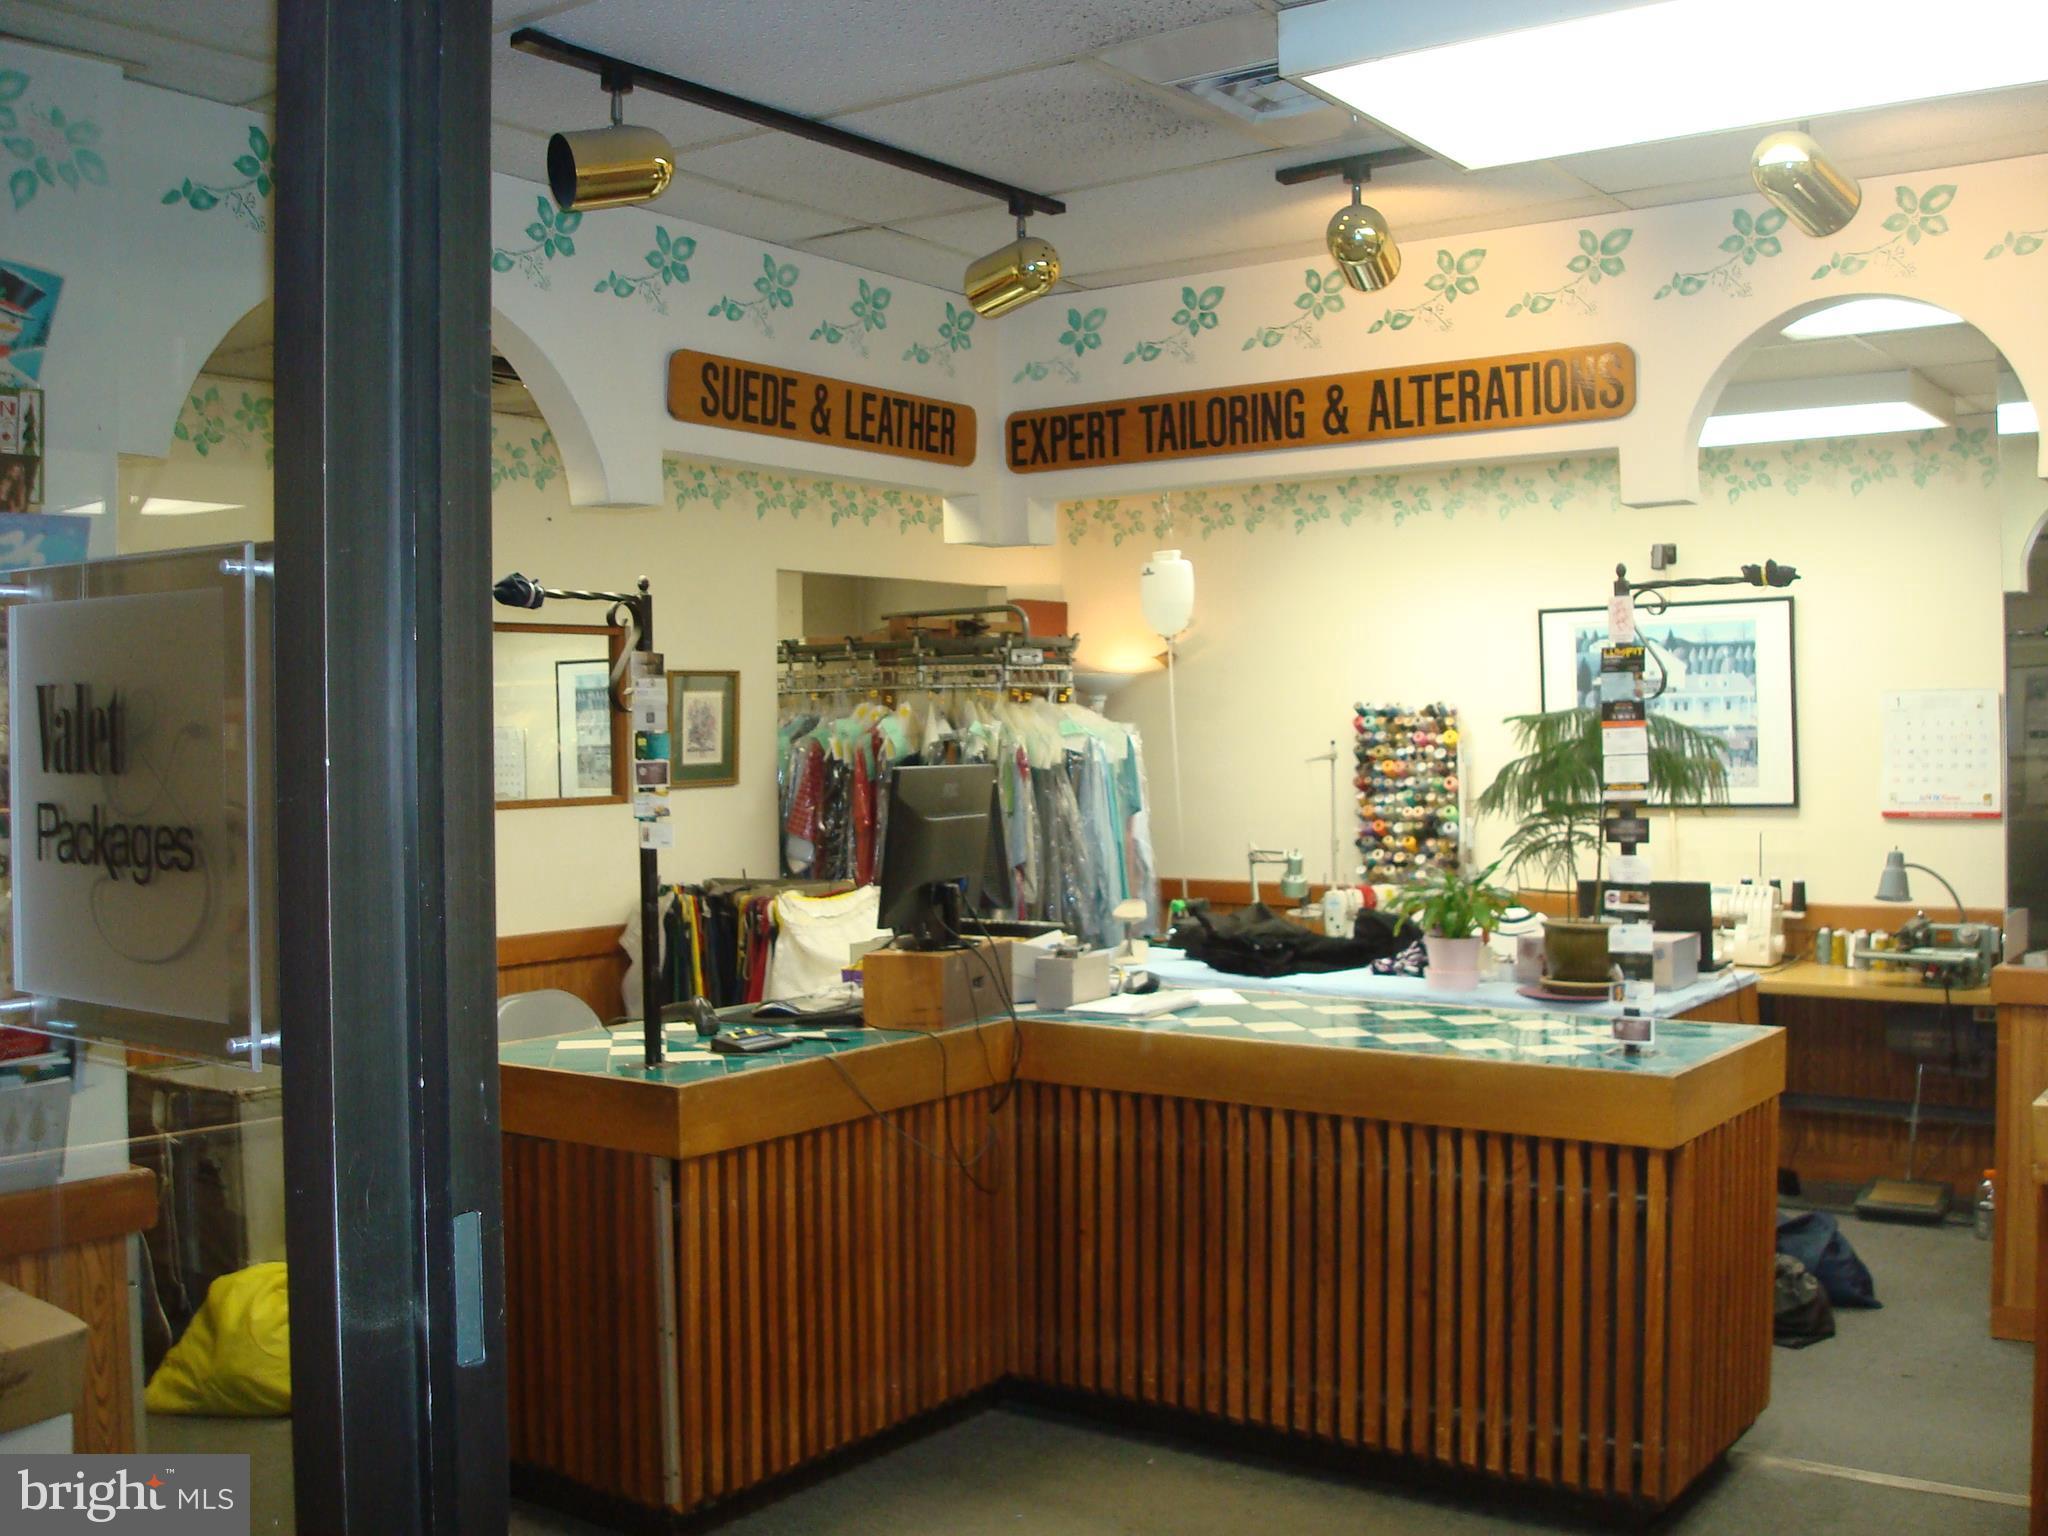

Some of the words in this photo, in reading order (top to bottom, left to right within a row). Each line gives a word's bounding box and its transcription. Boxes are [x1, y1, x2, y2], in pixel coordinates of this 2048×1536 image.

[701, 361, 798, 431] SUEDE
[810, 383, 831, 437] &
[845, 388, 956, 456] LEATHER
[1010, 408, 1126, 467] EXPERT
[1138, 387, 1305, 454] TAILORING
[1322, 383, 1349, 436] &
[1367, 350, 1625, 433] ALTERATIONS
[36, 683, 126, 775] Valet
[37, 802, 196, 886] Packages
